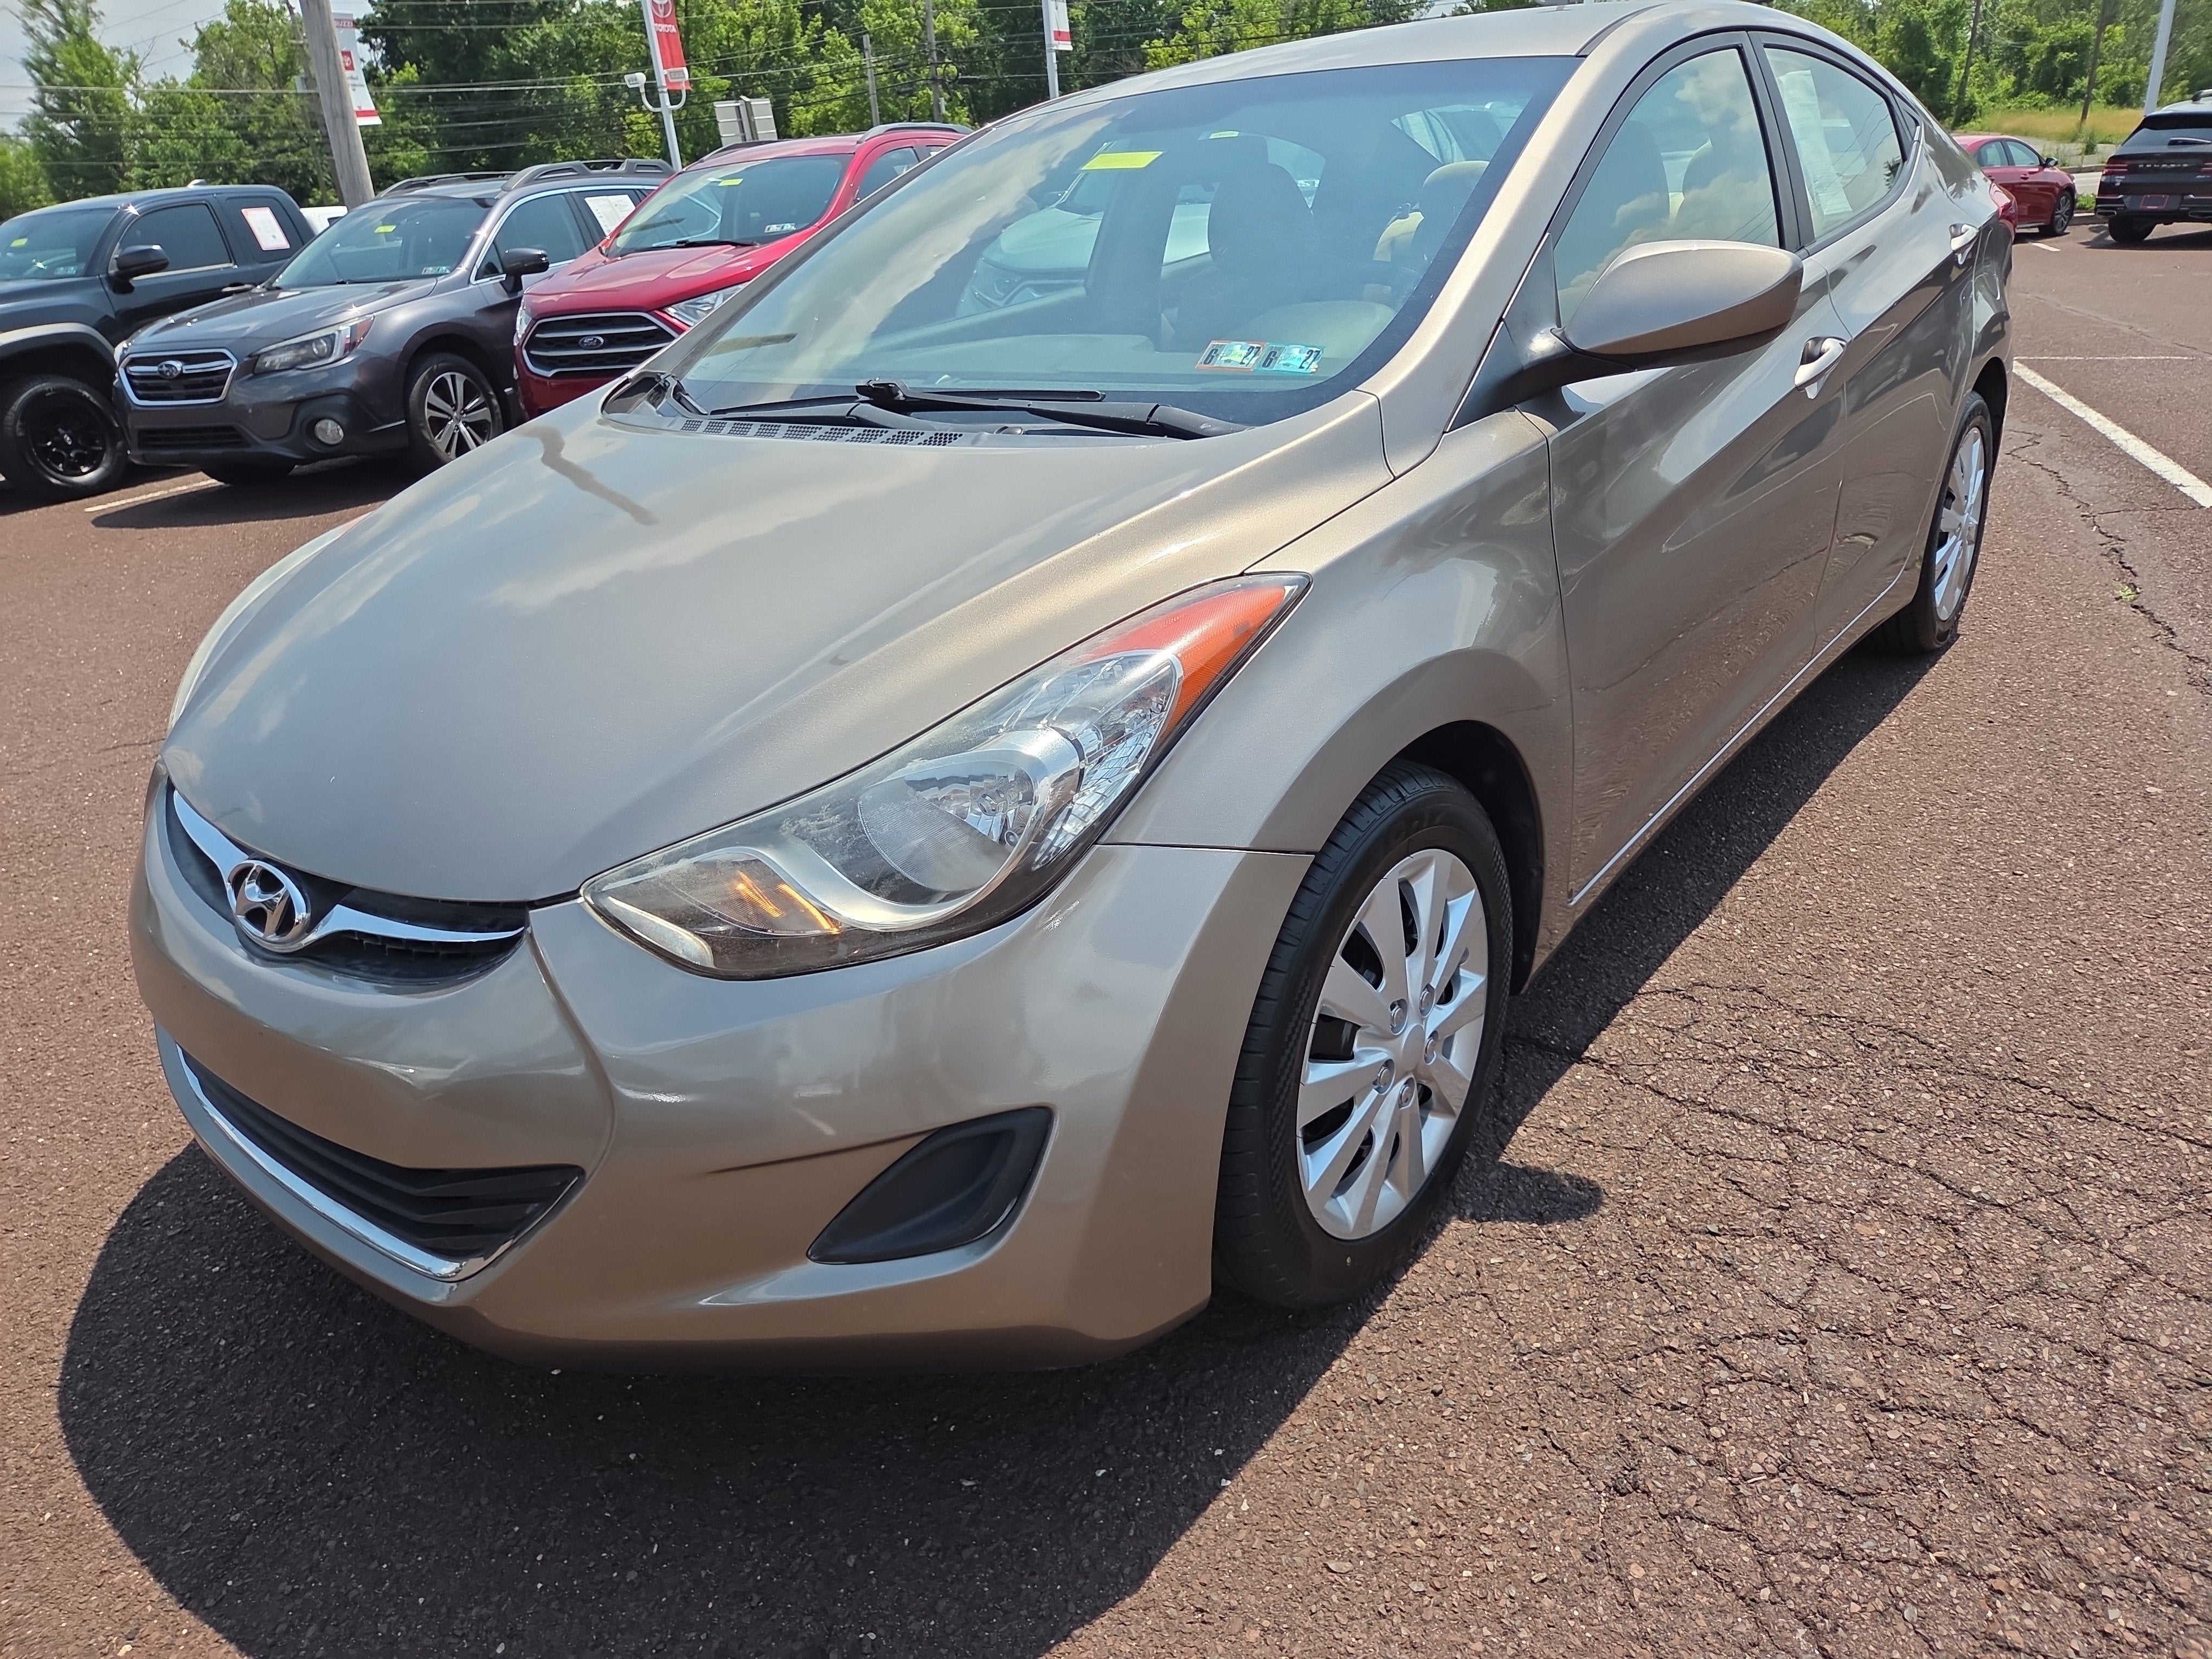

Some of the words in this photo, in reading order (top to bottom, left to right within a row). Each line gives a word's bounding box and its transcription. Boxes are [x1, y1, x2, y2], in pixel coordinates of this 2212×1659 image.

[654, 23, 677, 33] TOYOTA
[1203, 348, 1218, 364] 6
[1239, 346, 1261, 366] 27
[1262, 351, 1277, 368] 6
[1299, 349, 1320, 370] 27
